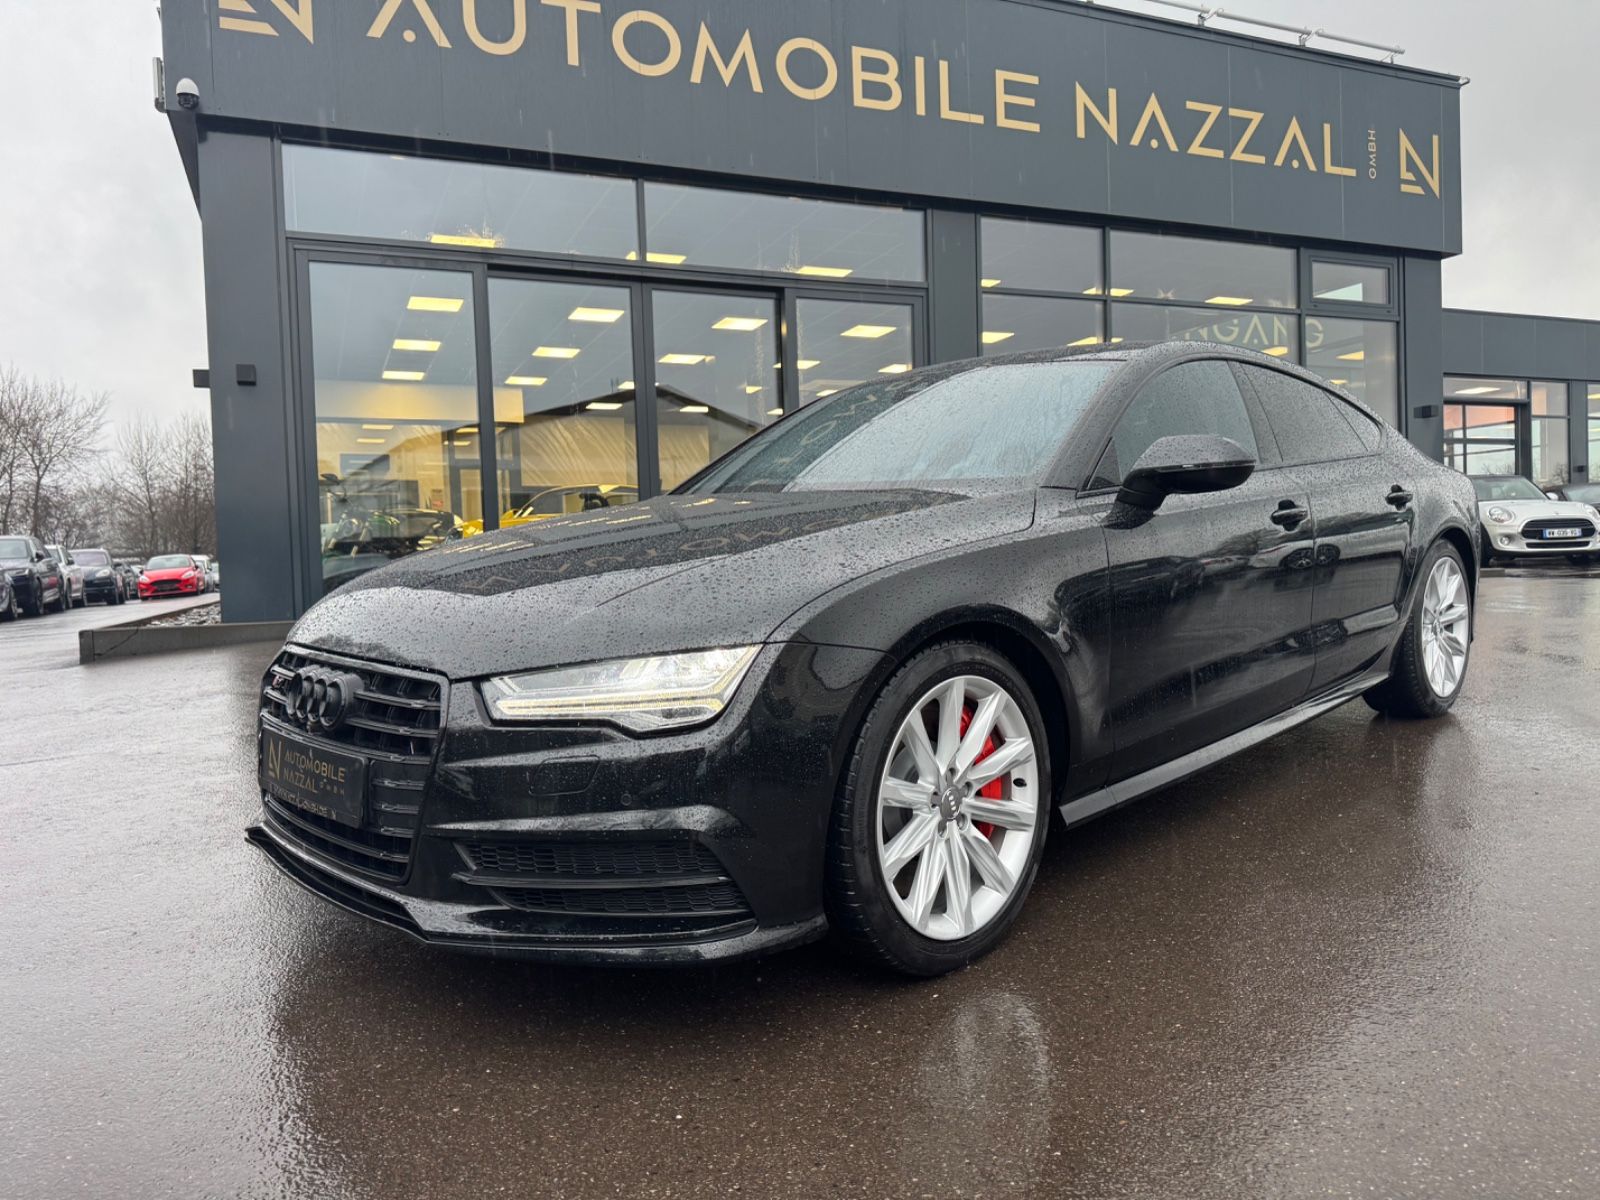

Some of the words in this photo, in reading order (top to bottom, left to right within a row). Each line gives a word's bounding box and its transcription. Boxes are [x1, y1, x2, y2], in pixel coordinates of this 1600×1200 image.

[366, 0, 1041, 133] AUTOMOBILE
[1075, 80, 1357, 178] NAZZAL
[1367, 129, 1377, 179] GMBH
[283, 768, 318, 794] NAZZAL
[284, 750, 346, 783] AUTOMOBILE
